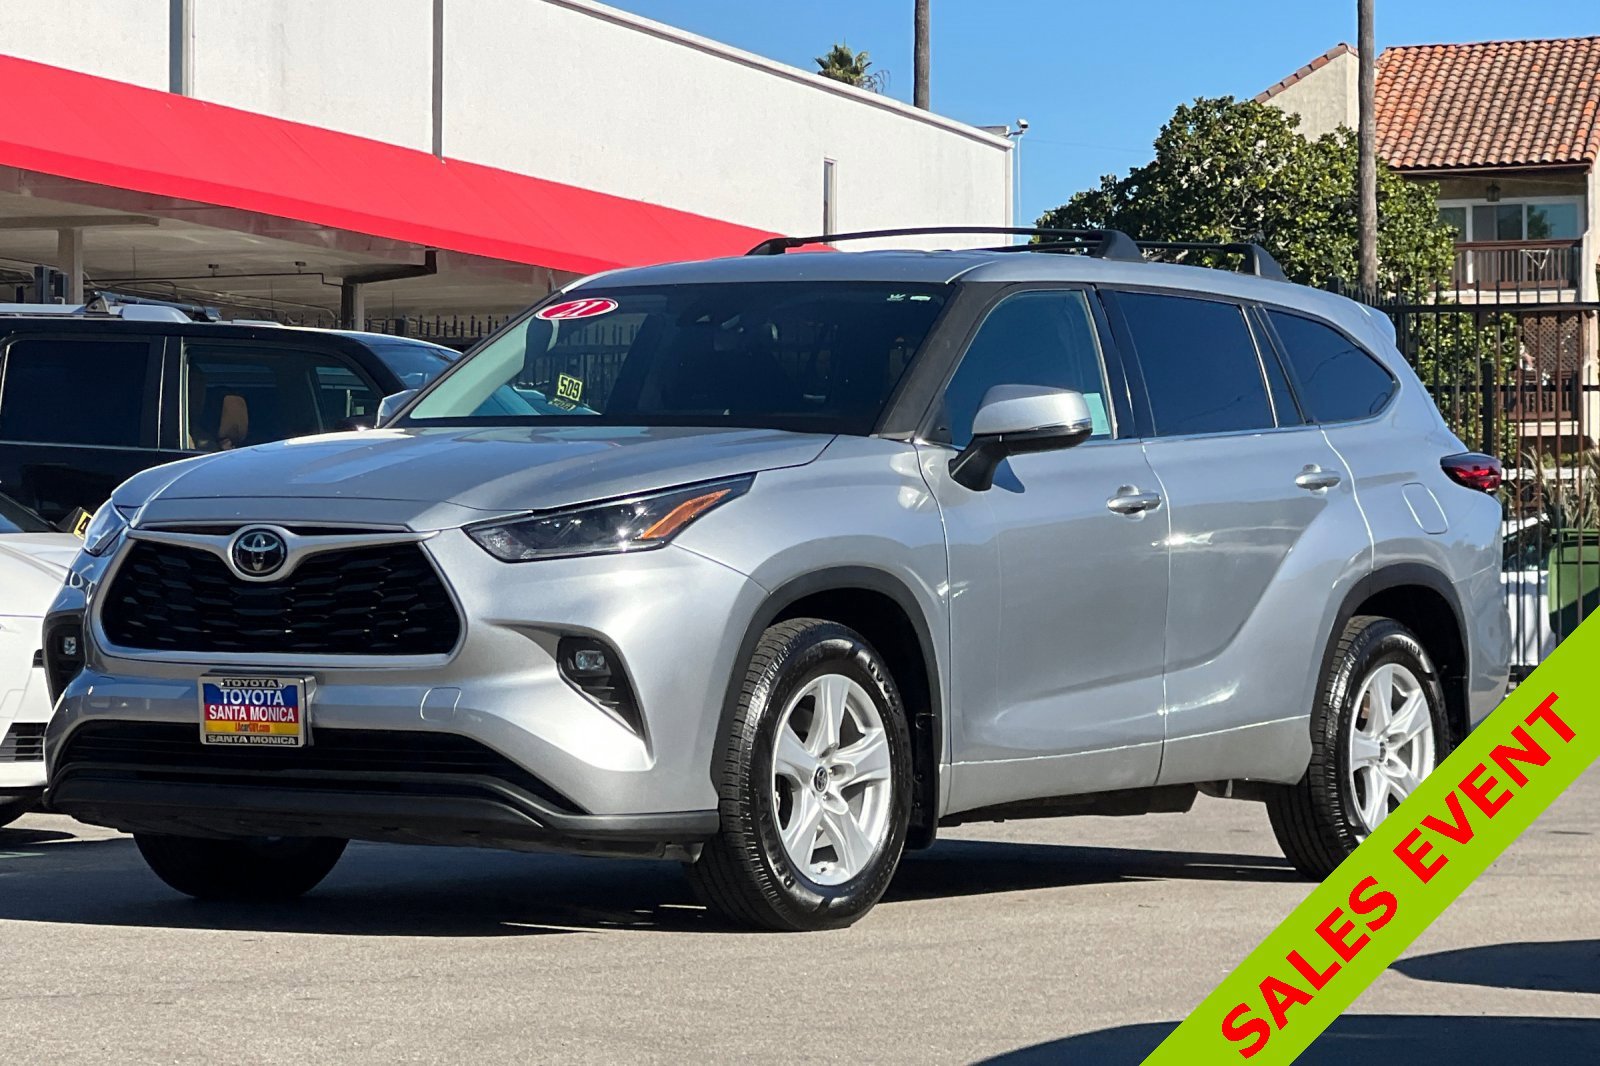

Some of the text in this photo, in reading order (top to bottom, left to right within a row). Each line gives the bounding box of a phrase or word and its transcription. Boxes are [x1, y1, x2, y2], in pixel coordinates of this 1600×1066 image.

[559, 376, 581, 399] 509
[224, 679, 277, 688] TOYOTA
[220, 689, 285, 706] TOYOTA
[209, 705, 295, 722] SANTA MONICA
[208, 735, 296, 745] SANTA MONICA
